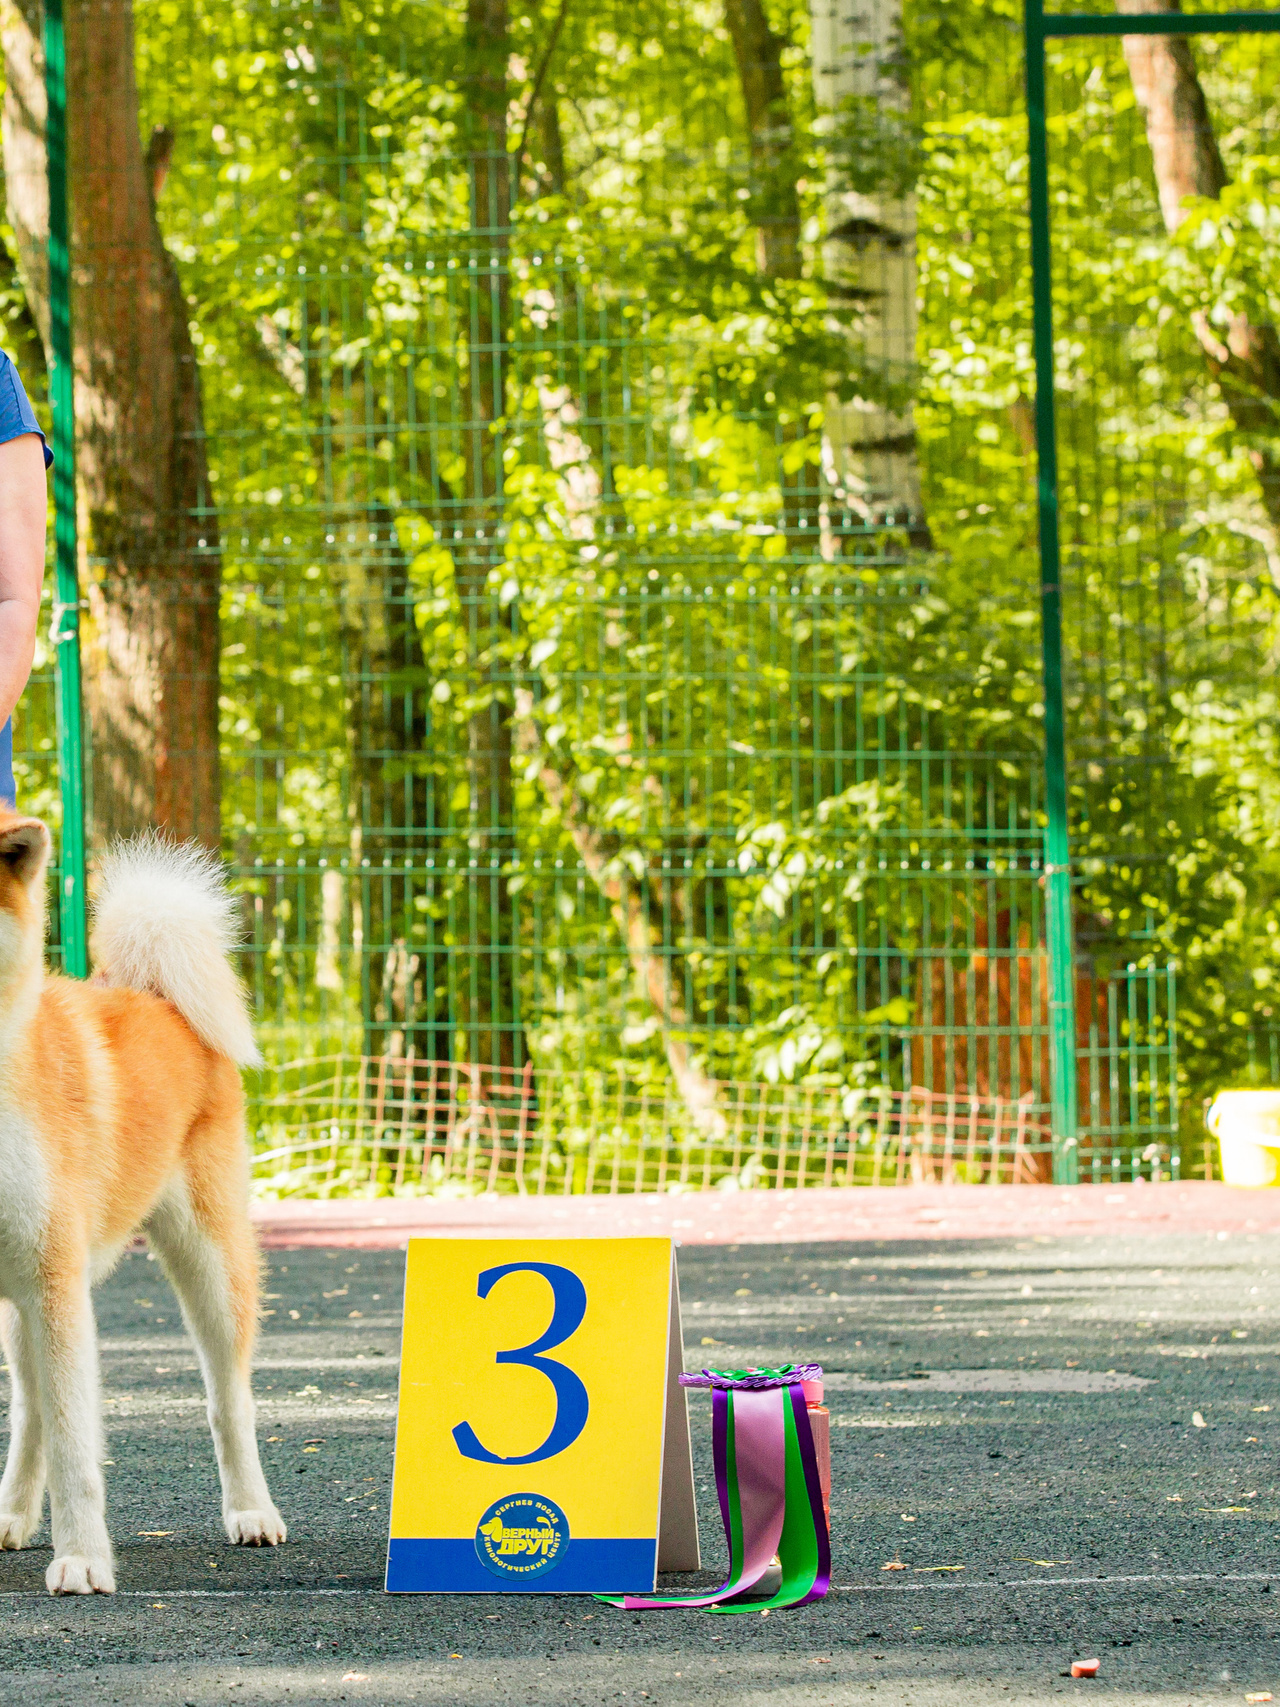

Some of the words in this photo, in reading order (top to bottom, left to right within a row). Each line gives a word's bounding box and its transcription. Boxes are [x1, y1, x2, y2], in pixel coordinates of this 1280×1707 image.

[451, 1261, 590, 1466] 3
[495, 1499, 533, 1516] СЕРГИЕВ
[535, 1502, 559, 1524] ПОСАД
[502, 1528, 554, 1539] ВЕРНЫЙ
[484, 1536, 548, 1572] КИНОЛОГИЧЕСКИЙ
[547, 1532, 561, 1558] ЦЕНТР
[496, 1538, 554, 1555] ДРУГ
